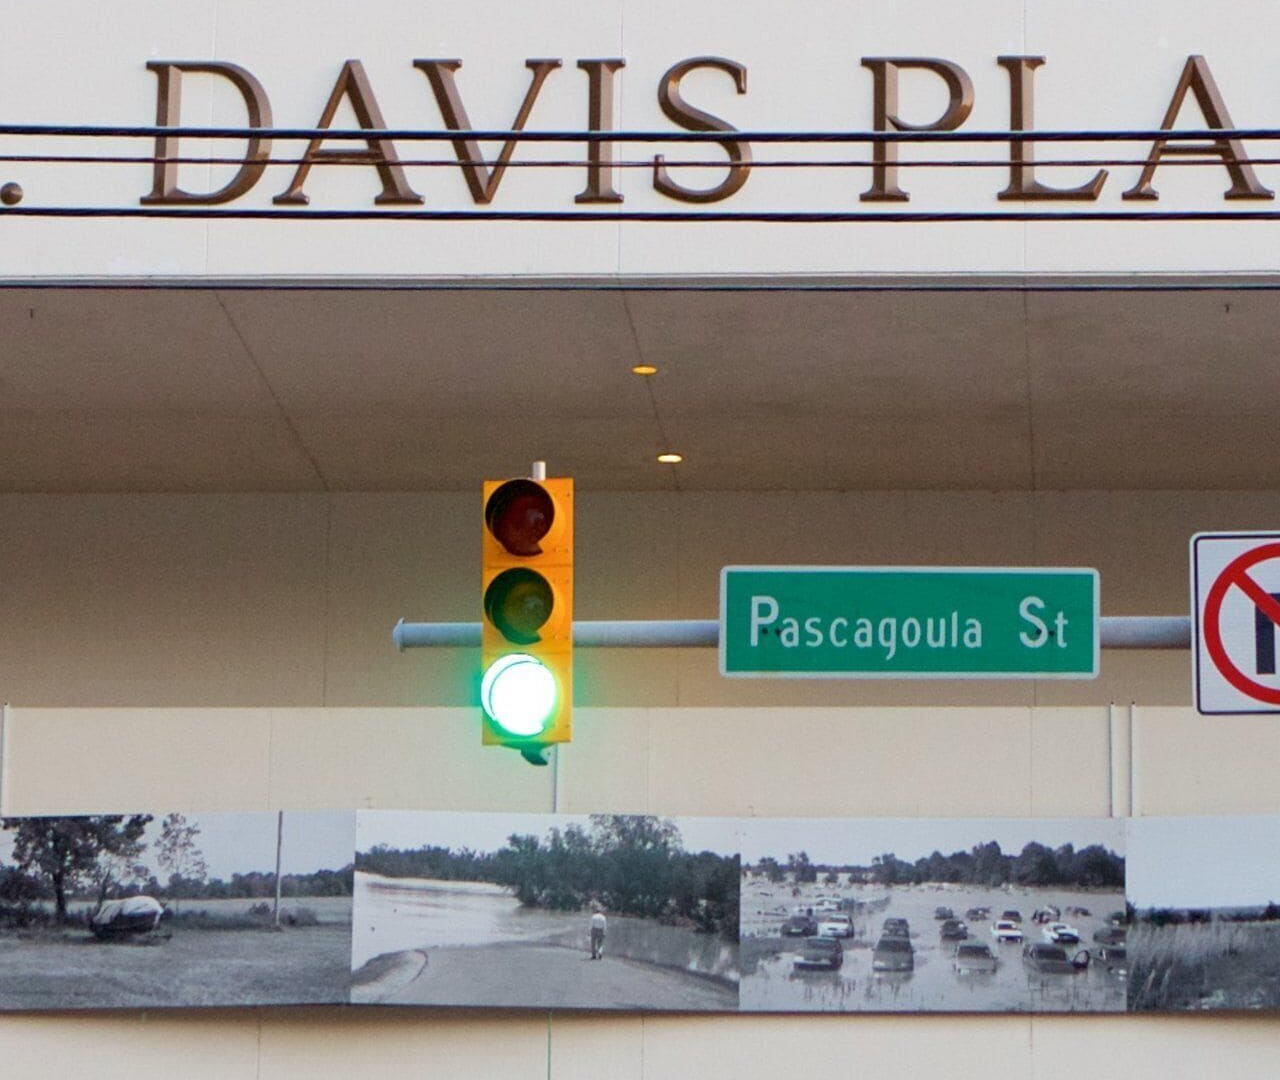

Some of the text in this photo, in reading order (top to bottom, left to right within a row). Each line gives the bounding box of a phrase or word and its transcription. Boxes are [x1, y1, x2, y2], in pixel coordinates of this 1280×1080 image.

[139, 55, 754, 206] DAVIS
[749, 595, 1069, 660] Pascagoula St
